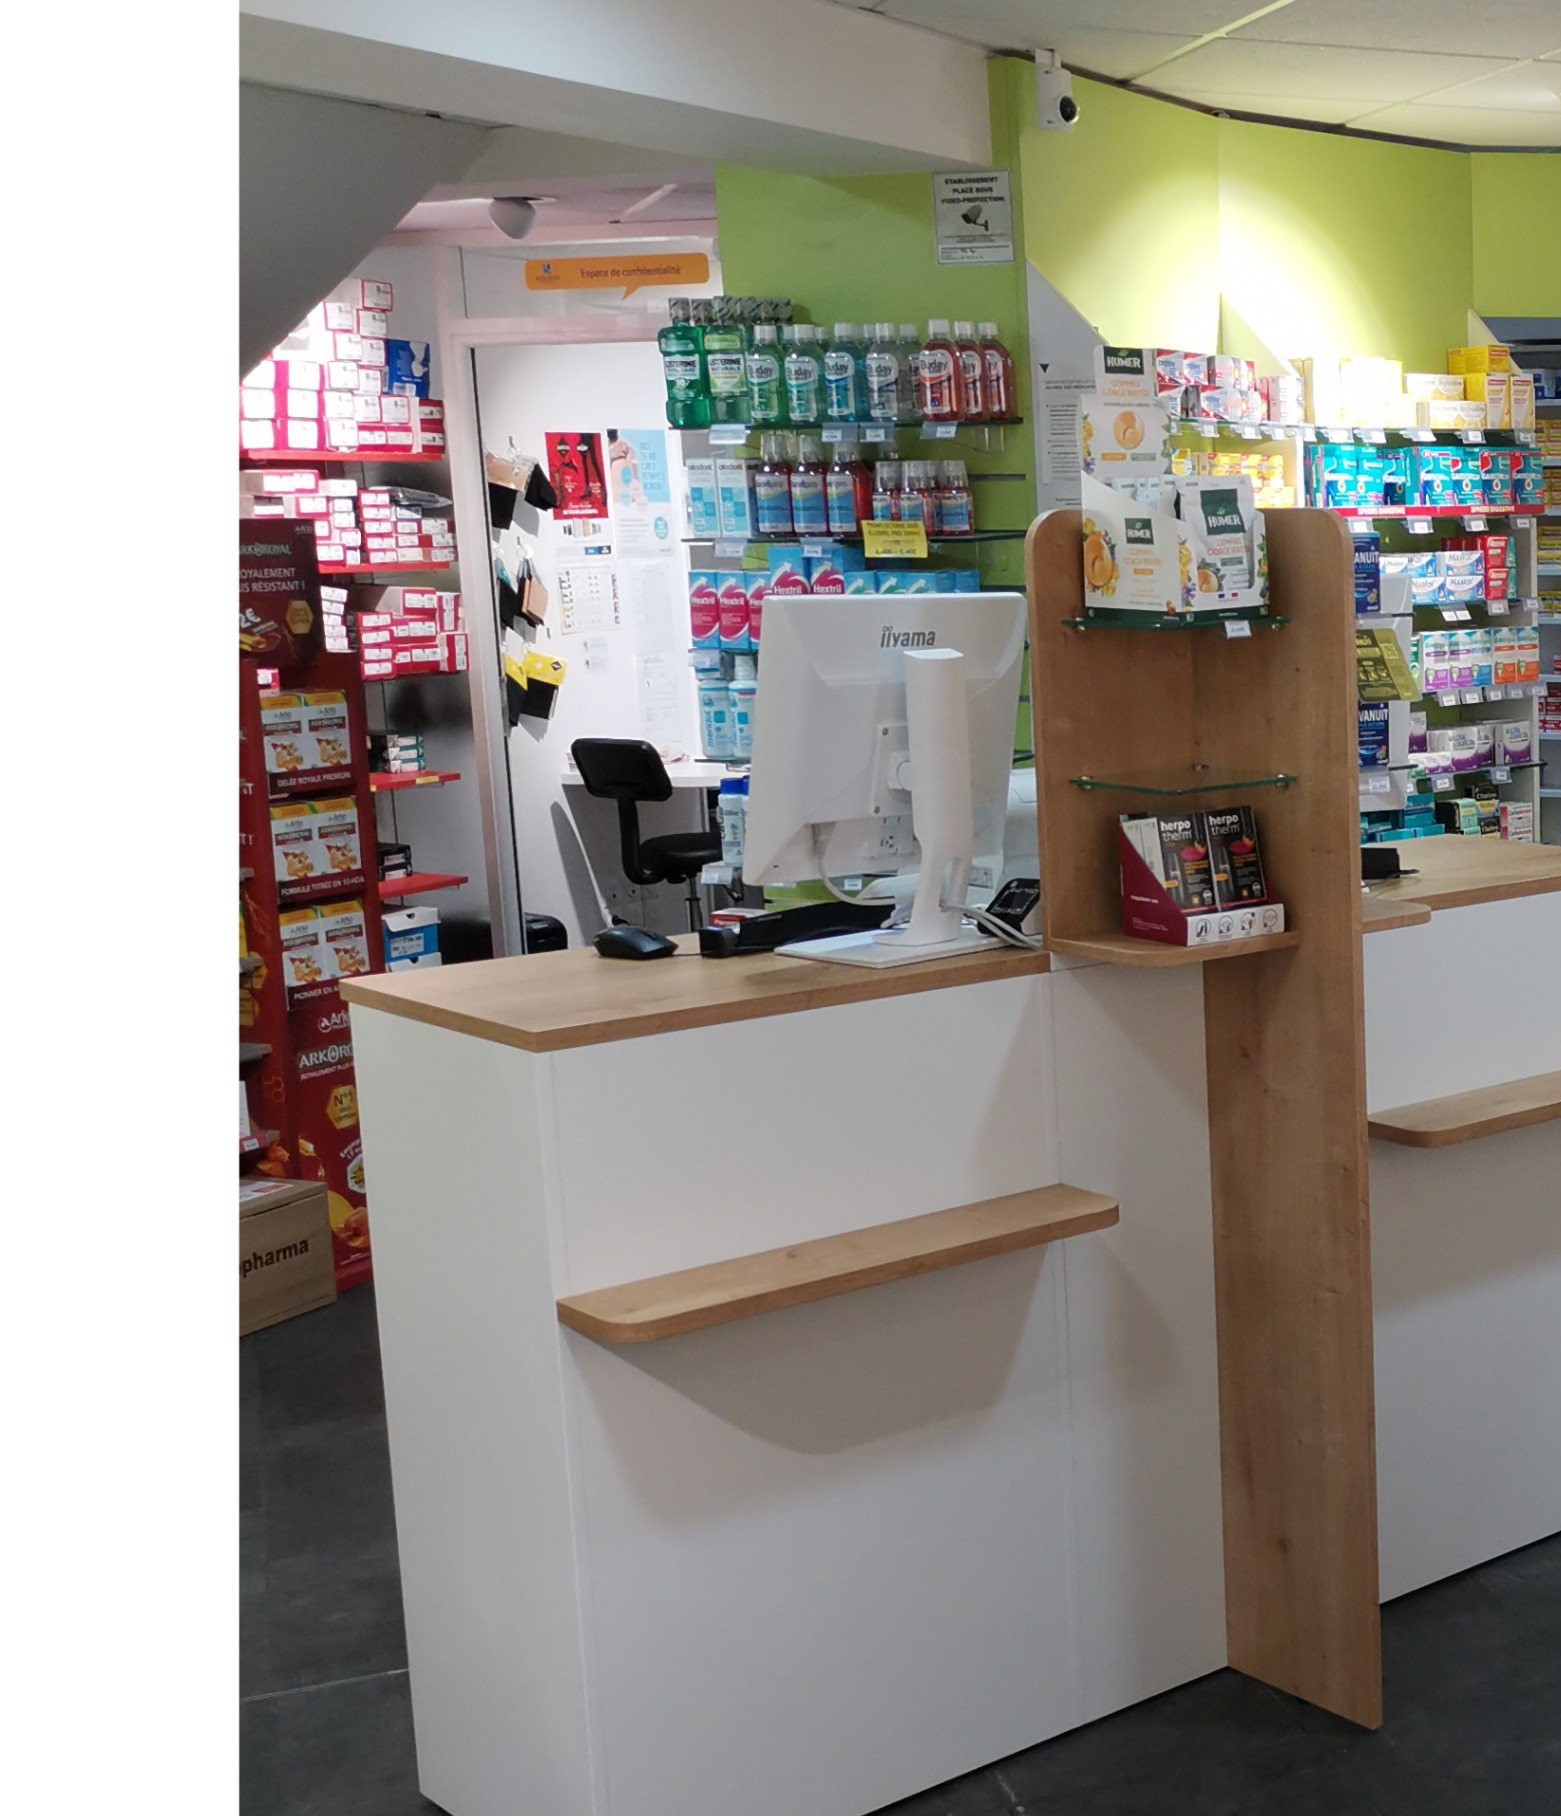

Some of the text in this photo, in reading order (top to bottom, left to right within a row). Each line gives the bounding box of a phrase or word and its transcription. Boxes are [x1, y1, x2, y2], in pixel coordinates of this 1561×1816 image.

[580, 265, 682, 279] Espace de confidentialité
[709, 358, 742, 367] LISTERINE
[1107, 356, 1141, 369] HUMER
[1490, 505, 1515, 513] DIGESTIVE
[1207, 514, 1241, 528] HUMER
[1127, 528, 1151, 538] HUMER
[240, 542, 292, 556] RKOROYAL
[1353, 552, 1380, 564] ANUIT
[240, 568, 296, 579] OYALEMENT
[252, 581, 299, 593] RÉSISTANT
[1450, 578, 1474, 586] Maalox
[774, 586, 803, 595] Hextril
[813, 585, 842, 593] Hextril
[690, 597, 716, 605] Hextril
[719, 597, 745, 605] Hextril
[881, 626, 936, 648] iiyama
[1359, 709, 1388, 722] VANUIT
[277, 771, 351, 787] GELÉE ROYALE PREMIUM
[1160, 820, 1191, 832] herpo
[1209, 814, 1239, 826] herpo
[1210, 824, 1240, 836] therm
[1161, 831, 1192, 842] therm
[281, 884, 312, 896] FORMULE
[239, 1239, 310, 1278] pharma
